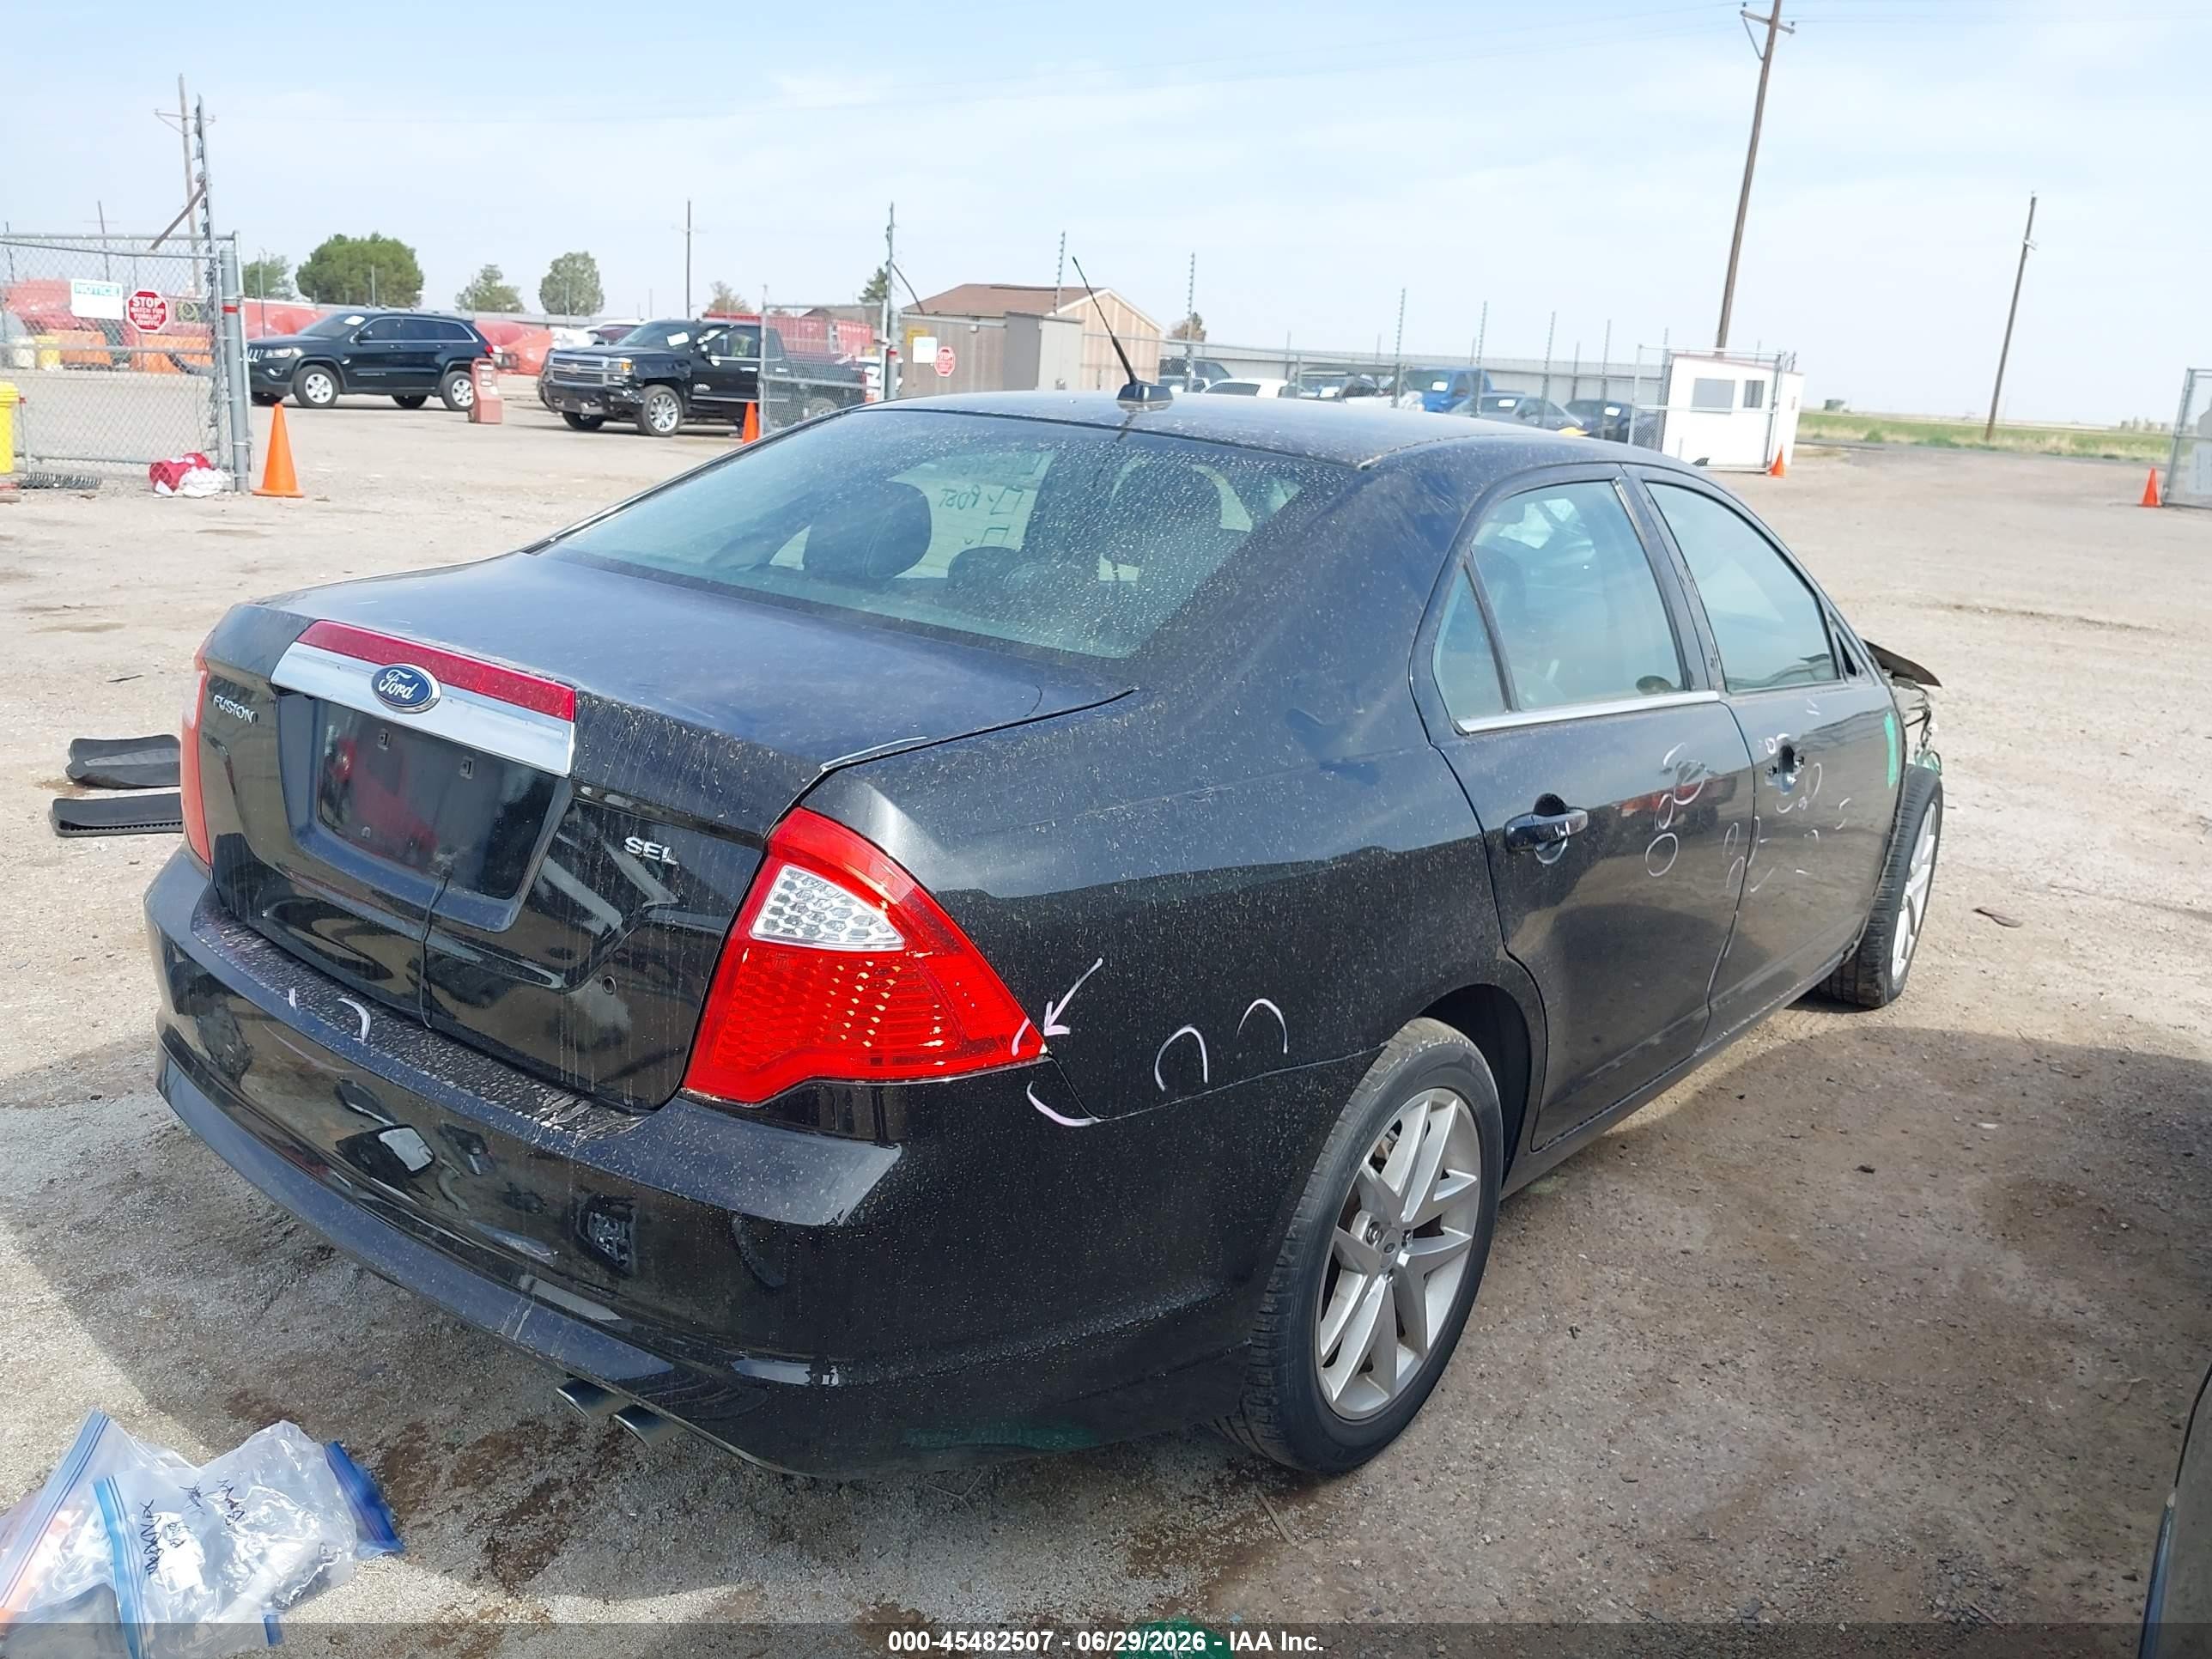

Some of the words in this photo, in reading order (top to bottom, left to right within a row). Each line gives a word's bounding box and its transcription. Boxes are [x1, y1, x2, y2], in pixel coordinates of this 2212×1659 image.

[132, 297, 162, 308] STOP
[378, 668, 419, 700] Ford
[213, 695, 256, 723] FUSION
[623, 836, 679, 866] SEL
